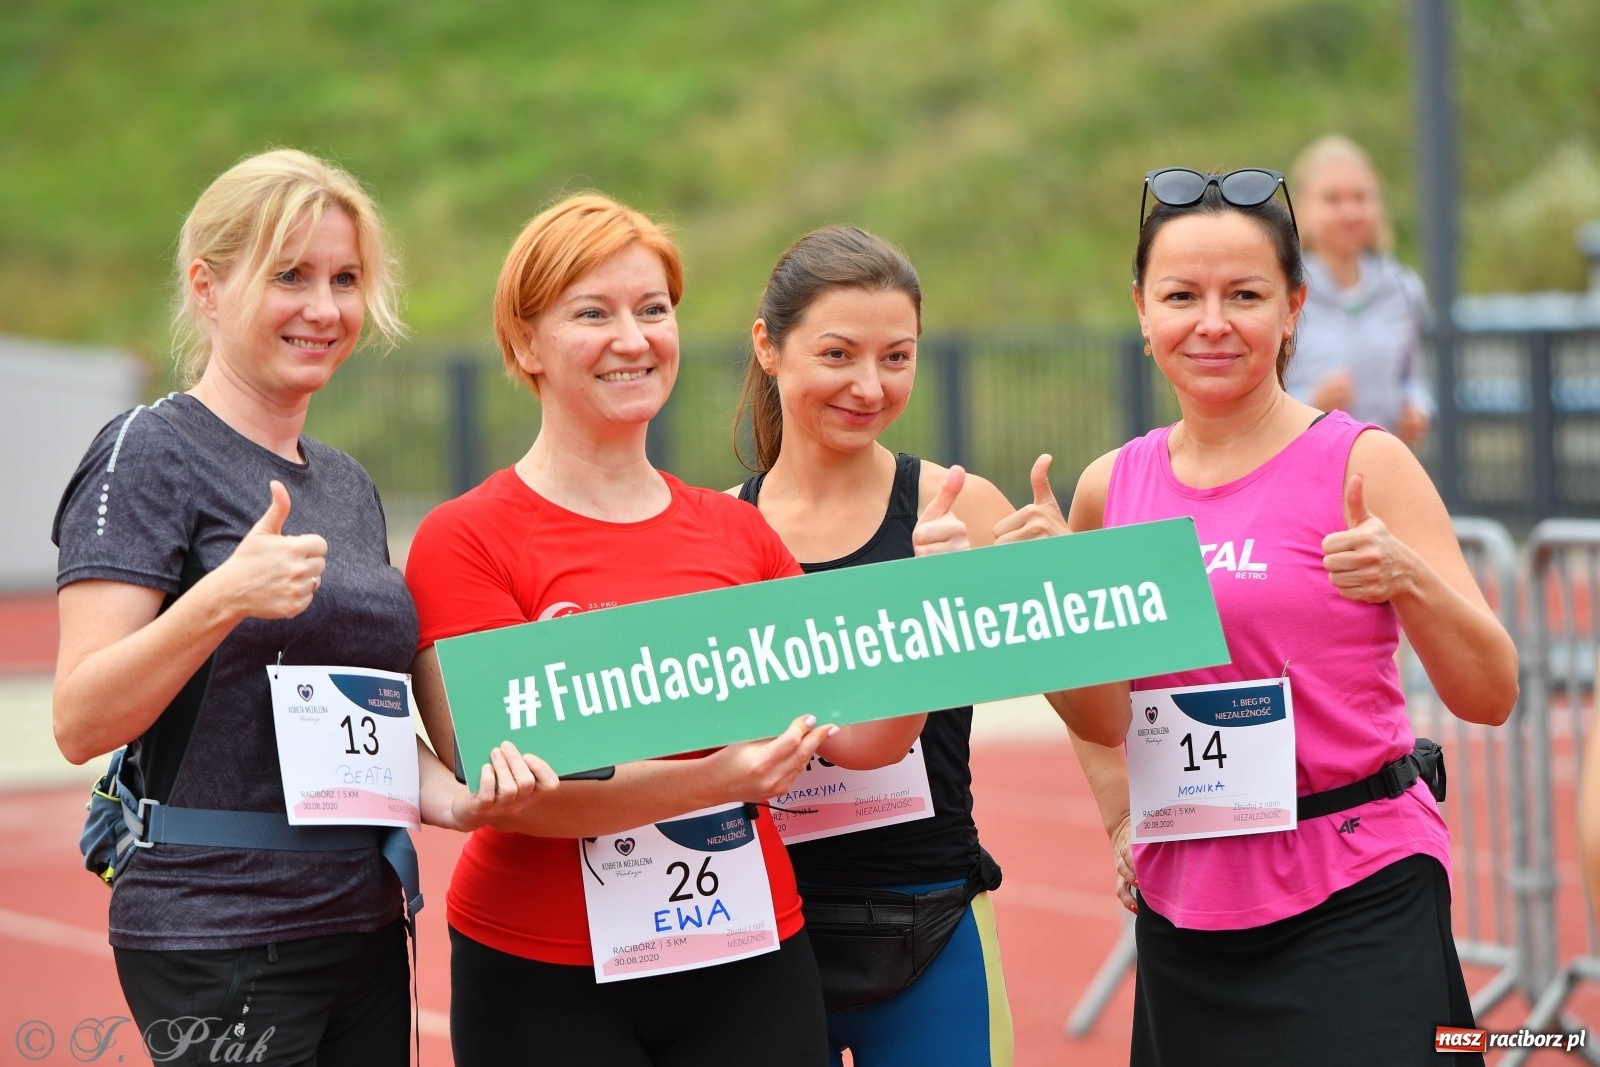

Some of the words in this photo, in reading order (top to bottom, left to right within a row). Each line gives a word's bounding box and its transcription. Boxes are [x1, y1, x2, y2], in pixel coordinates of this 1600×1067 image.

[1234, 572, 1267, 580] RETRO
[503, 581, 1168, 731] #FundacjaKobietaNiezalezna
[1232, 700, 1239, 708] 1.
[1240, 698, 1258, 707] BIEG
[1259, 696, 1271, 705] PO
[1215, 706, 1272, 720] NIEZALEŻNOŚĆ
[341, 715, 380, 756] 13
[1180, 730, 1227, 772] 14
[335, 764, 393, 785] BEATA
[301, 789, 335, 799] RACIBÓRZ
[348, 790, 359, 798] KM
[776, 782, 846, 804] KATARZYNA
[854, 794, 882, 806] Zbuduj
[890, 788, 910, 799] nami
[1177, 780, 1226, 798] MONIKA
[302, 802, 339, 810] 30.08.2020
[855, 798, 913, 817] NIEZALEŻNOŚĆ
[1142, 808, 1172, 818] RACIBÓRZ
[1185, 806, 1196, 814] KM
[726, 820, 738, 830] BIEG
[737, 818, 744, 827] PO
[1143, 821, 1174, 829] 30.08.2020
[666, 856, 719, 902] 26
[654, 899, 731, 932] EWA
[613, 941, 656, 955] RACIBÓRZ
[666, 940, 672, 948] 5
[673, 937, 688, 946] KM
[614, 953, 660, 967] 30.08.2020
